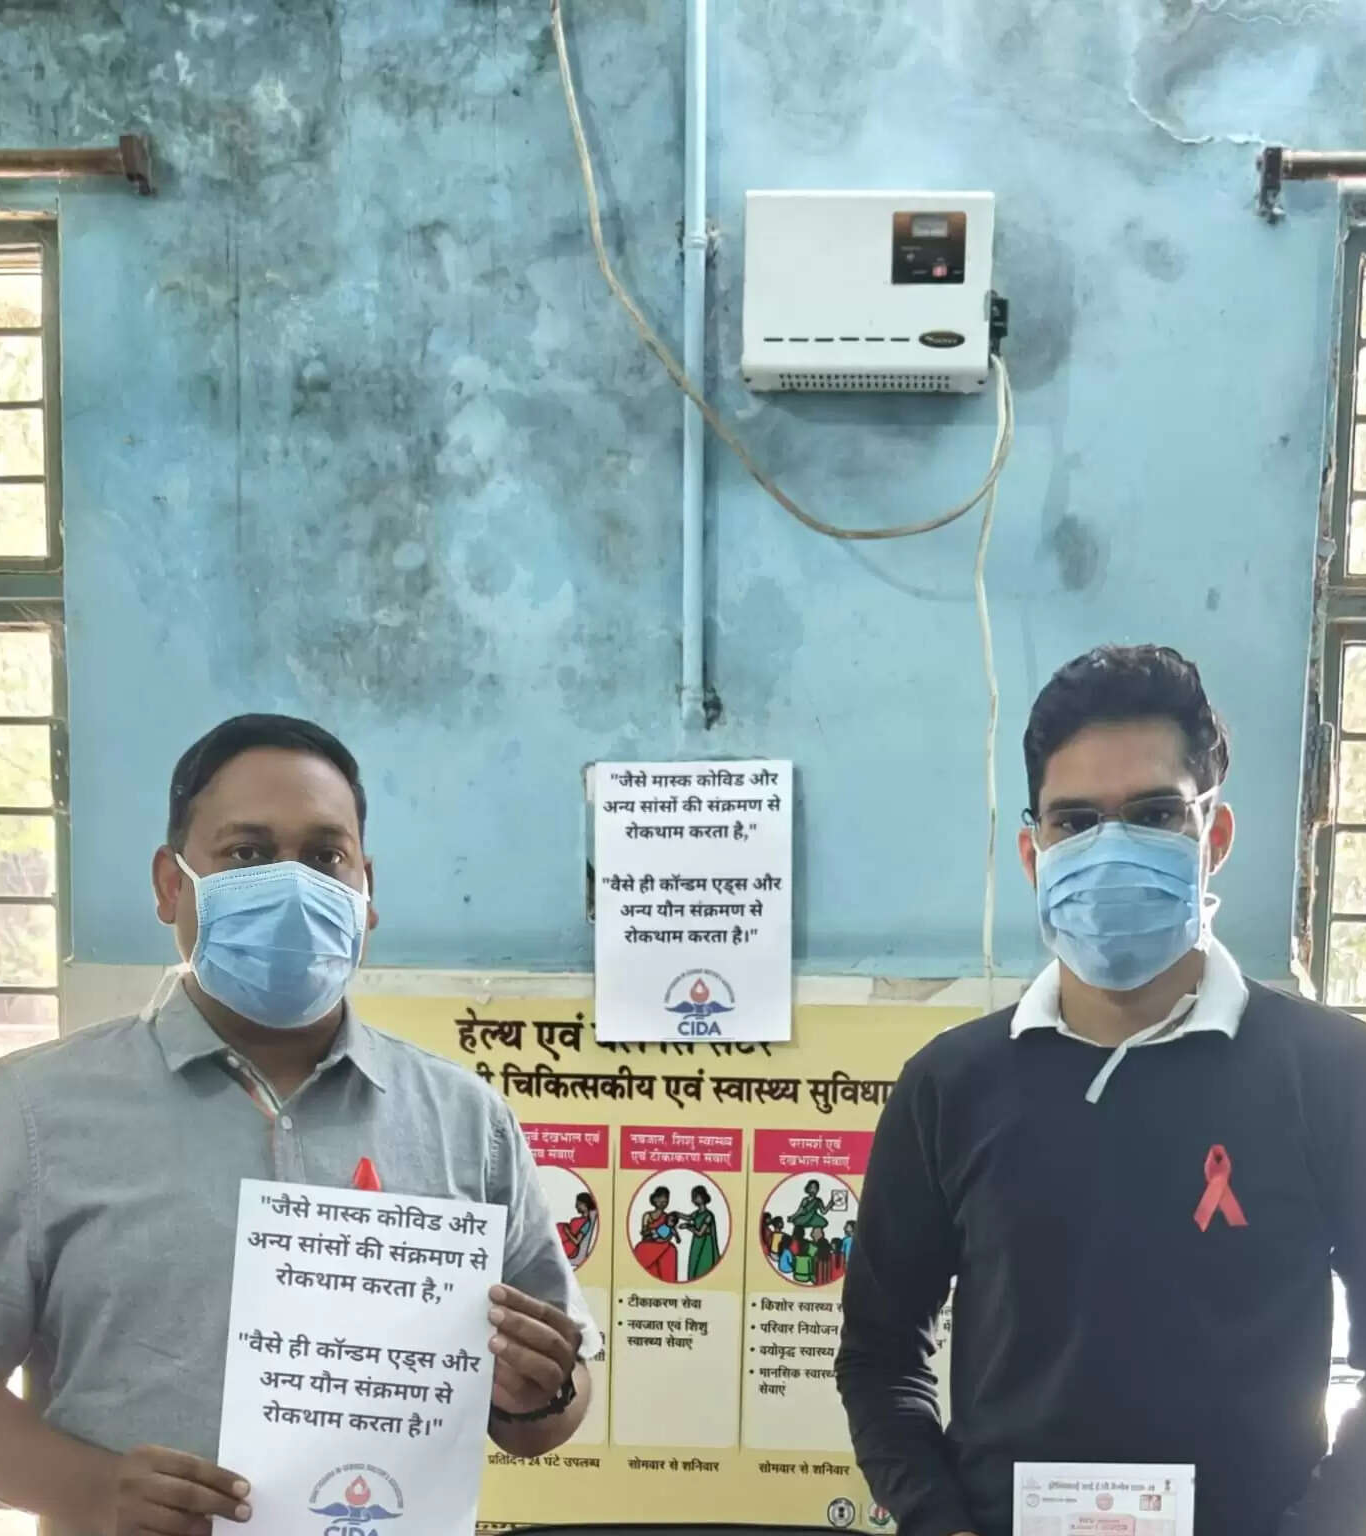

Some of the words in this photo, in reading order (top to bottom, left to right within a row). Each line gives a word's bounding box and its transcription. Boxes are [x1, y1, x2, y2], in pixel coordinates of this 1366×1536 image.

[611, 770, 647, 787] "जैसे
[651, 775, 692, 787] मास्क
[696, 769, 745, 786] कोविड
[750, 769, 778, 785] और
[603, 801, 635, 813] अन्य
[682, 796, 703, 812] की
[707, 797, 763, 812] संक्रमण
[767, 794, 781, 811] से
[626, 822, 685, 839] रोकथाम
[689, 825, 729, 838] करता
[733, 820, 756, 841] है,"
[603, 874, 635, 891] "वैसे
[639, 874, 655, 893] ही
[753, 873, 782, 890] और
[620, 905, 653, 917] अन्य
[657, 899, 685, 917] यौन
[689, 901, 745, 917] संक्रमण
[749, 899, 763, 916] से
[625, 926, 684, 943] रोकथाम
[688, 930, 728, 943] करता
[731, 925, 757, 945] है।"
[455, 1007, 527, 1053] हेल्थ
[533, 1012, 584, 1061] एवं
[677, 1021, 722, 1036] CIDA
[500, 1063, 657, 1100] चिकित्सकीय
[661, 1068, 704, 1109] एवं
[709, 1076, 801, 1104] स्वास्थ्य
[807, 1070, 893, 1114] सुविधा
[261, 1193, 311, 1218] "जैसे
[317, 1204, 371, 1224] मास्क
[377, 1204, 443, 1231] कोविड
[449, 1212, 487, 1236] और
[248, 1232, 292, 1251] अन्य
[355, 1236, 384, 1260] की
[389, 1241, 465, 1268] संक्रमण
[470, 1248, 488, 1270] से
[276, 1263, 357, 1292] रोकथाम
[362, 1277, 417, 1298] करता
[422, 1276, 453, 1304] है,"
[627, 1293, 677, 1308] टीकाकरण
[761, 1297, 795, 1311] किशोर
[760, 1320, 794, 1334] परिवार
[798, 1320, 839, 1334] नियोजन
[239, 1329, 283, 1354] "वैसे
[289, 1334, 311, 1359] ही
[442, 1349, 481, 1373] और
[260, 1372, 305, 1390] अन्य
[310, 1370, 349, 1395] यौन
[354, 1376, 430, 1402] संक्रमण
[435, 1381, 454, 1404] से
[263, 1402, 344, 1428] रोकथाम
[349, 1414, 403, 1433] करता
[408, 1413, 443, 1438] है।"
[627, 1458, 665, 1472] सोमवार
[669, 1458, 679, 1472] से
[682, 1458, 719, 1473] शनिवार
[759, 1460, 795, 1475] सोमवार
[812, 1462, 850, 1476] शनिवार
